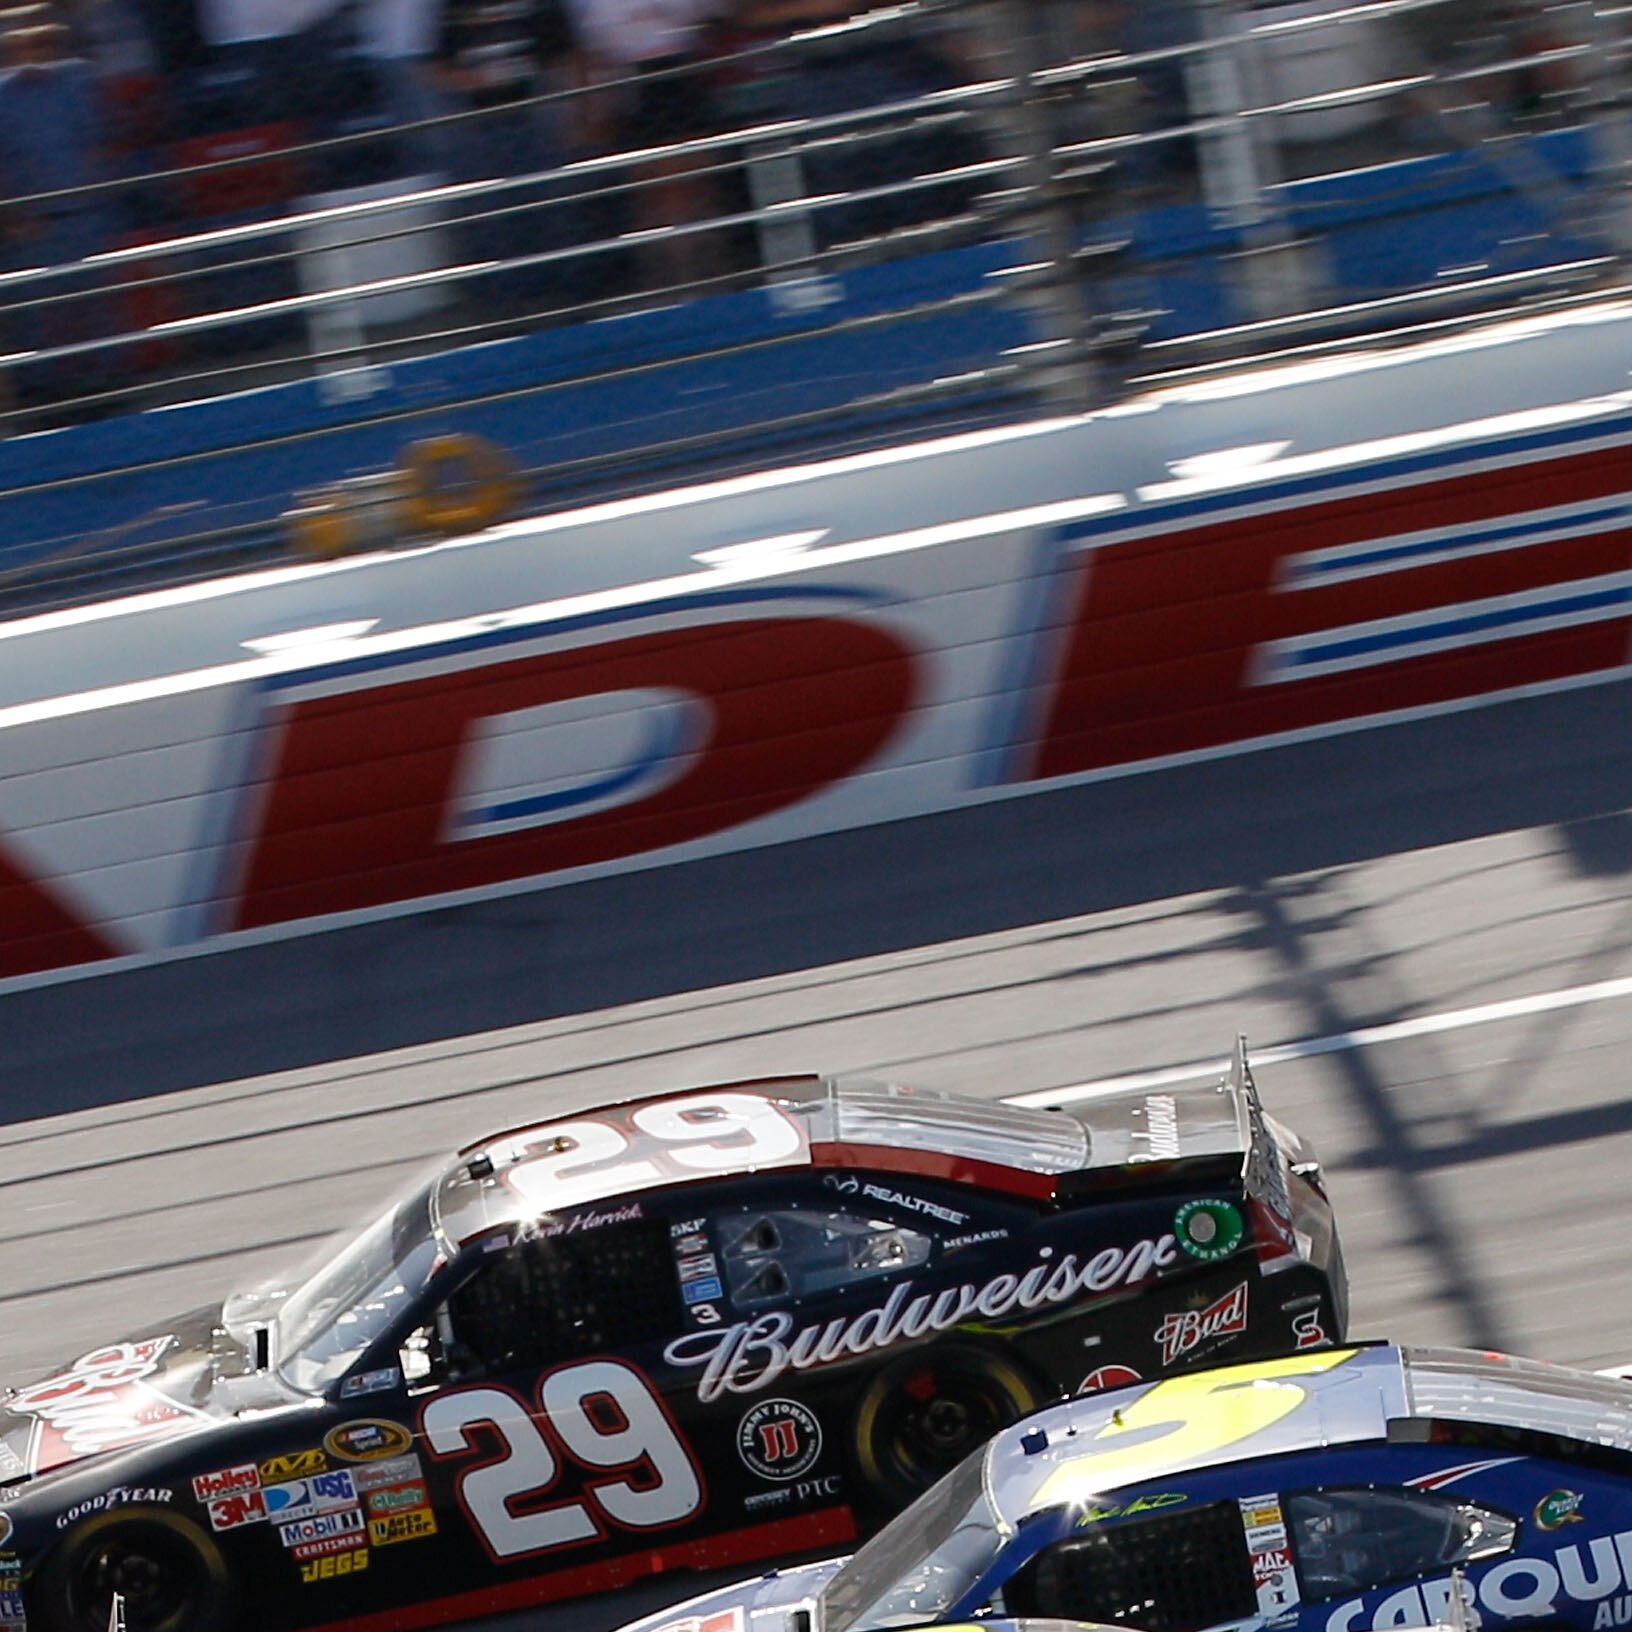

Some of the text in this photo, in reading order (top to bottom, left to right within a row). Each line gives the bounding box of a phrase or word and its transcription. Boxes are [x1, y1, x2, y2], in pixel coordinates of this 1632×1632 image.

[484, 1093, 808, 1199] 29
[568, 1203, 644, 1235] Harvick
[862, 1183, 969, 1226] REALTREE
[1174, 1198, 1233, 1226] AMERICAN
[670, 1218, 708, 1236] SKF
[943, 1229, 1009, 1250] MENARDS
[1181, 1230, 1244, 1261] ETHANOL
[664, 1233, 1178, 1403] Budweiser
[690, 1304, 721, 1324] 3
[1154, 1290, 1248, 1356] Bud
[742, 1404, 816, 1447] JIMMY JOHN'S
[758, 1419, 799, 1463] JJ
[422, 1360, 702, 1558] 29
[194, 1470, 259, 1495] Holley
[314, 1471, 355, 1500] USG
[796, 1475, 842, 1499] PTC
[55, 1486, 174, 1530] GOODYEAR
[213, 1491, 268, 1529] 3M
[389, 1513, 423, 1530] Auto
[284, 1517, 338, 1542] Mobil
[295, 1535, 363, 1557] CRAFTSMAN
[302, 1550, 369, 1583] JEGS
[1253, 1551, 1290, 1574] MAC
